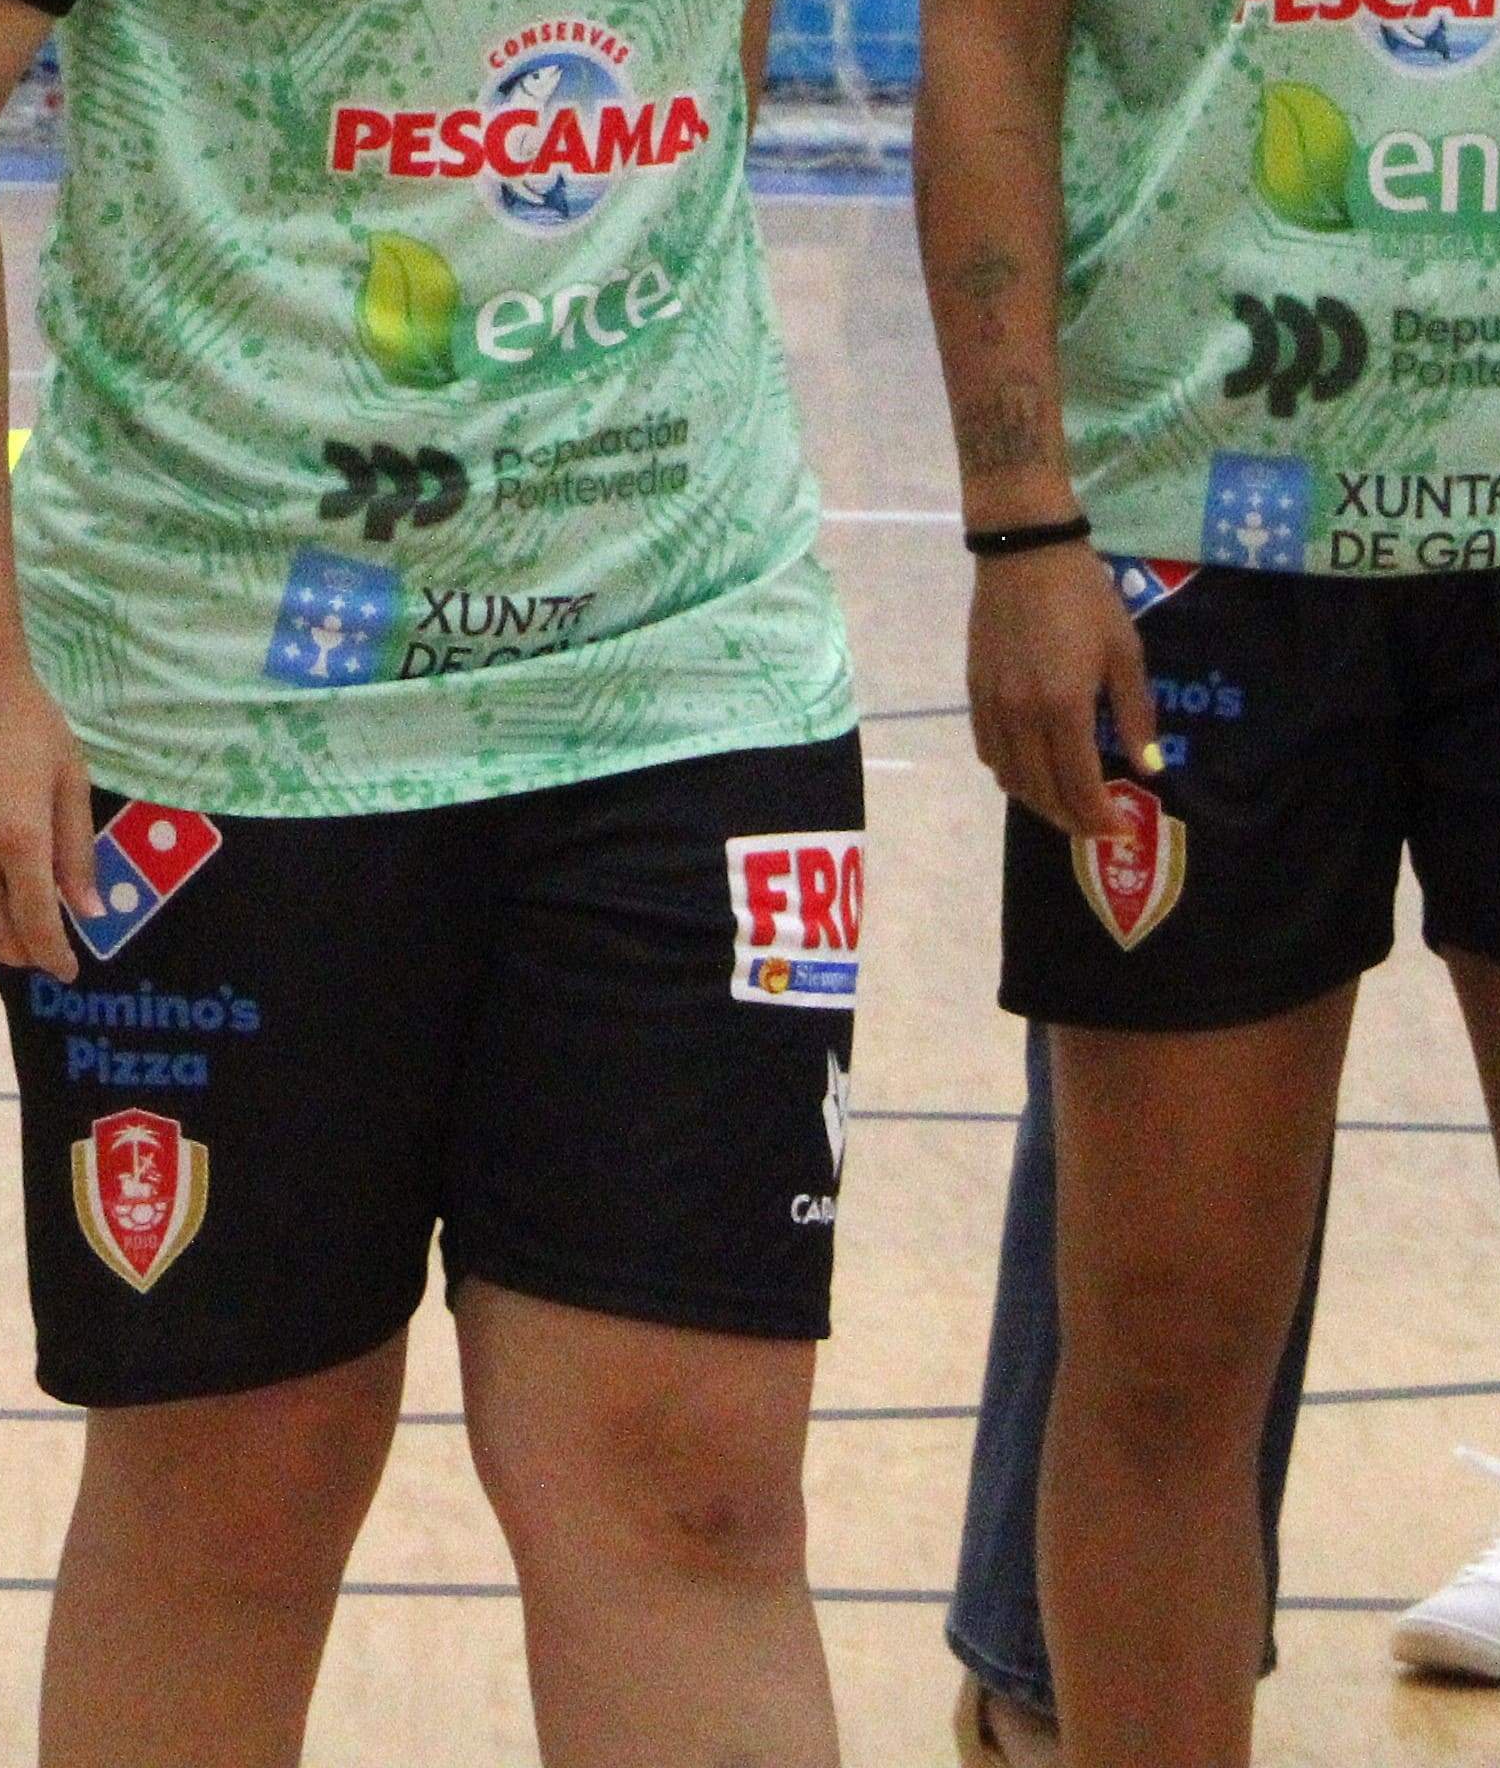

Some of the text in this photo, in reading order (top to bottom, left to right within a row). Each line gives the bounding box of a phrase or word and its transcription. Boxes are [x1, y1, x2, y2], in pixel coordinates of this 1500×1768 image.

[489, 22, 629, 70] CONSERVAS
[331, 95, 710, 178] PESCAMA
[475, 262, 683, 363] ence
[1329, 532, 1395, 570] DE
[418, 587, 598, 637] XUNTA
[30, 977, 262, 1033] Domino's
[66, 1037, 209, 1087] Pizza
